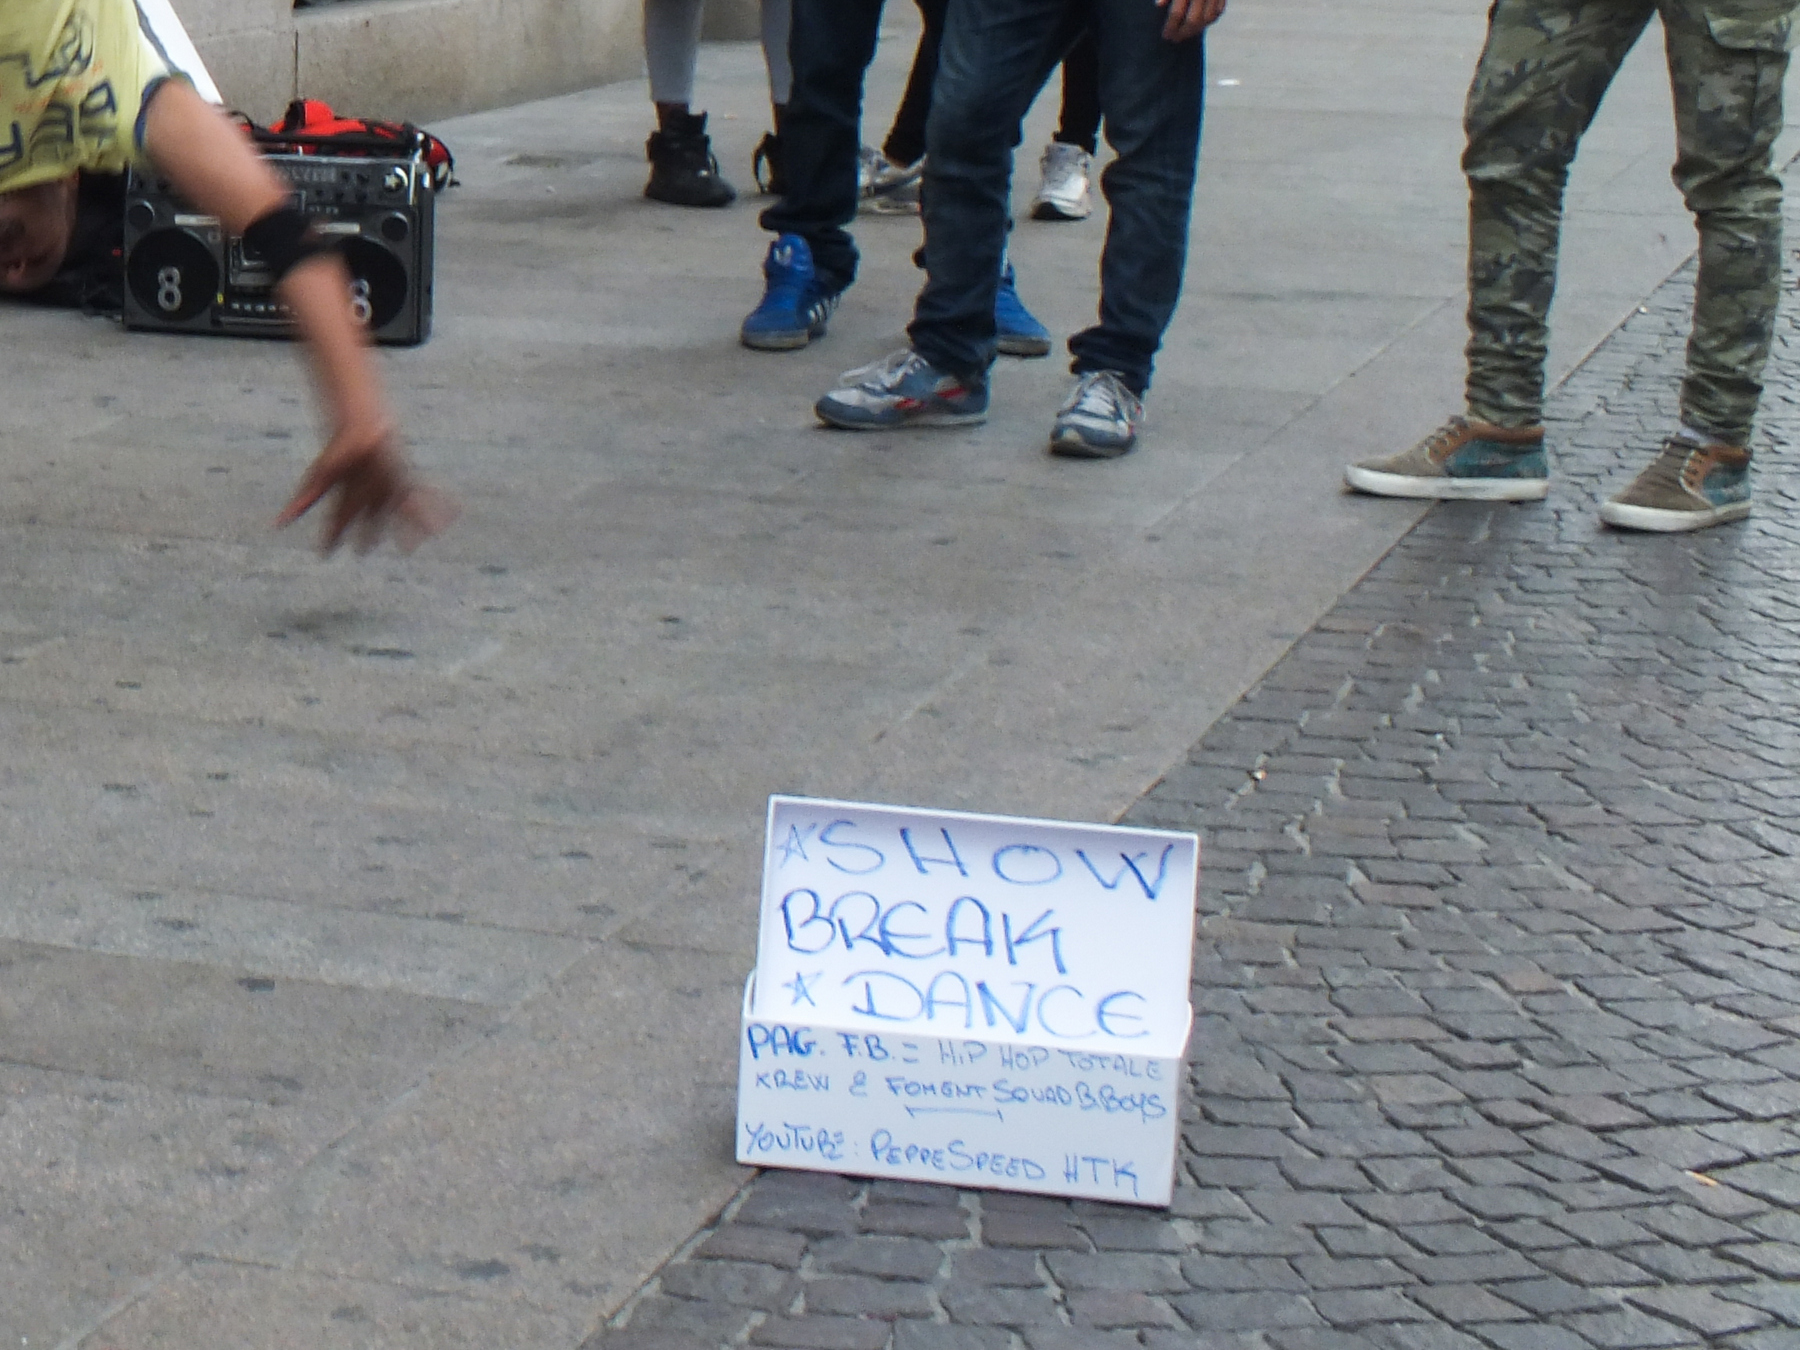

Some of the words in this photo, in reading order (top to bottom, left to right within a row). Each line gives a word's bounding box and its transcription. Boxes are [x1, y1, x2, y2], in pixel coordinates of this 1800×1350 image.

[818, 818, 1174, 901] SHOW
[780, 887, 1068, 976] BREAK
[842, 969, 1151, 1039] DANCE
[756, 1068, 830, 1092] KREW
[999, 1043, 1050, 1071] HOP
[1057, 1047, 1163, 1081] TOTALE
[1062, 1152, 1139, 1198] HTK
